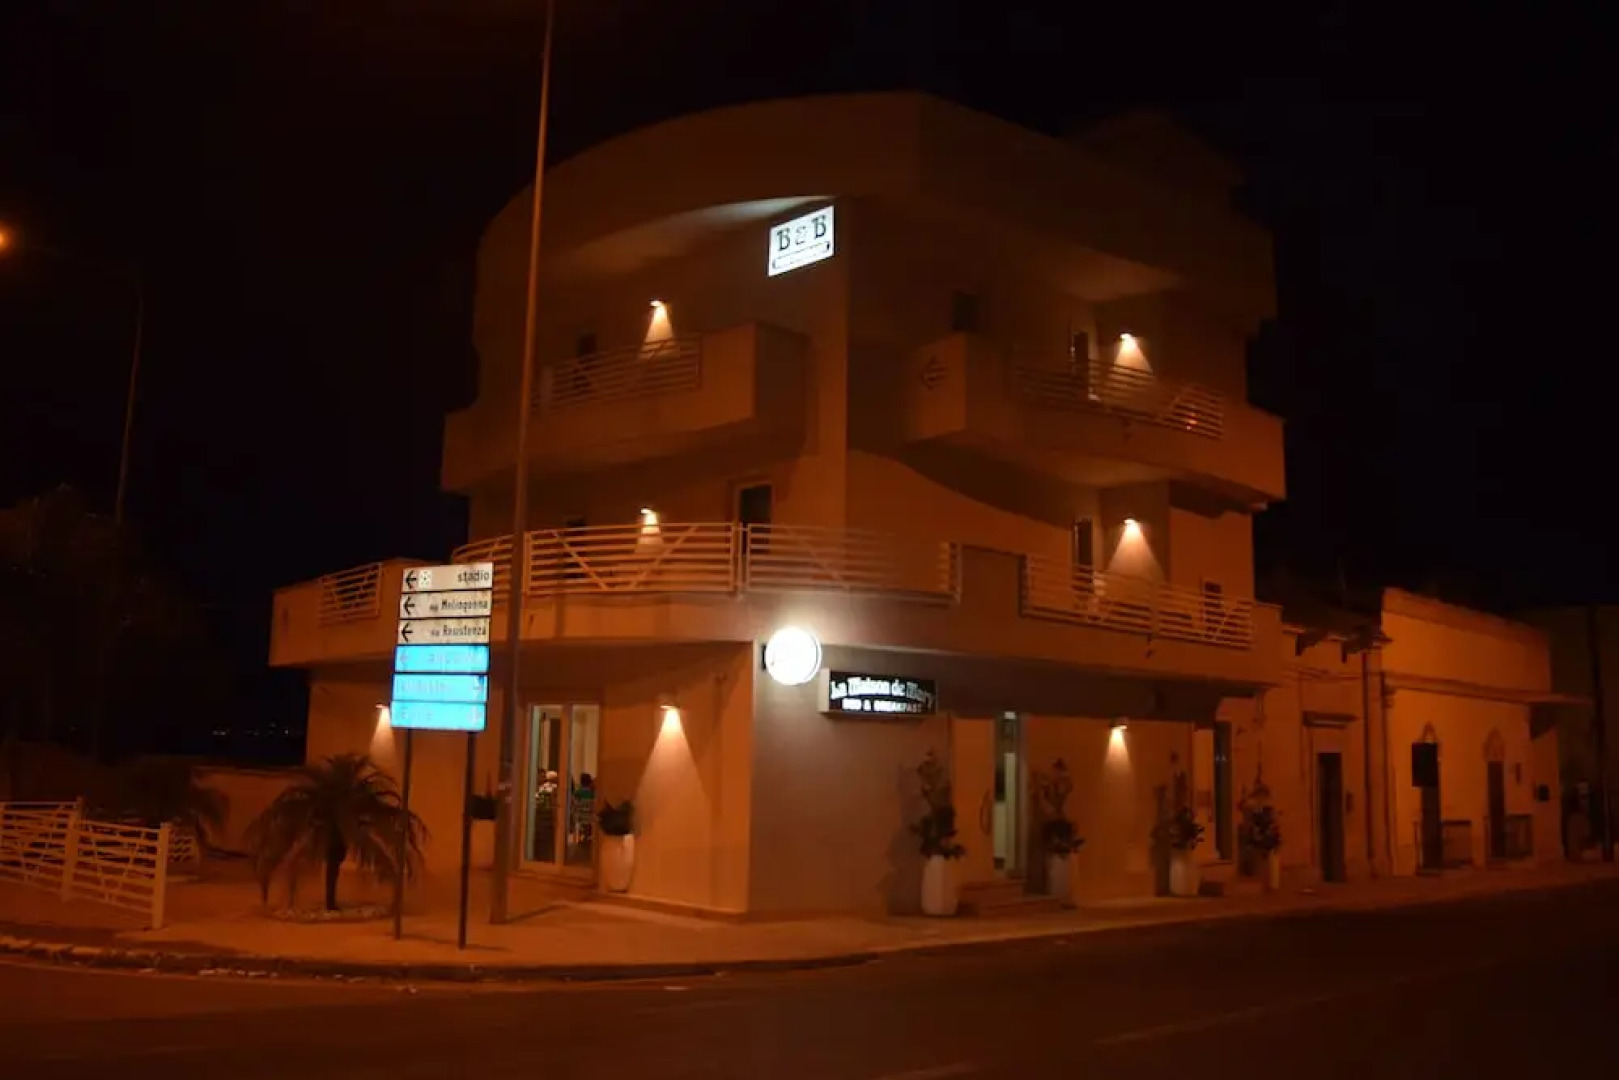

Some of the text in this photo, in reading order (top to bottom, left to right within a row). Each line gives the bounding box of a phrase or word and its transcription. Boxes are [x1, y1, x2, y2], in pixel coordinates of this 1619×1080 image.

[457, 569, 490, 584] stadio
[443, 624, 487, 636] Resistenza
[892, 679, 905, 696] de
